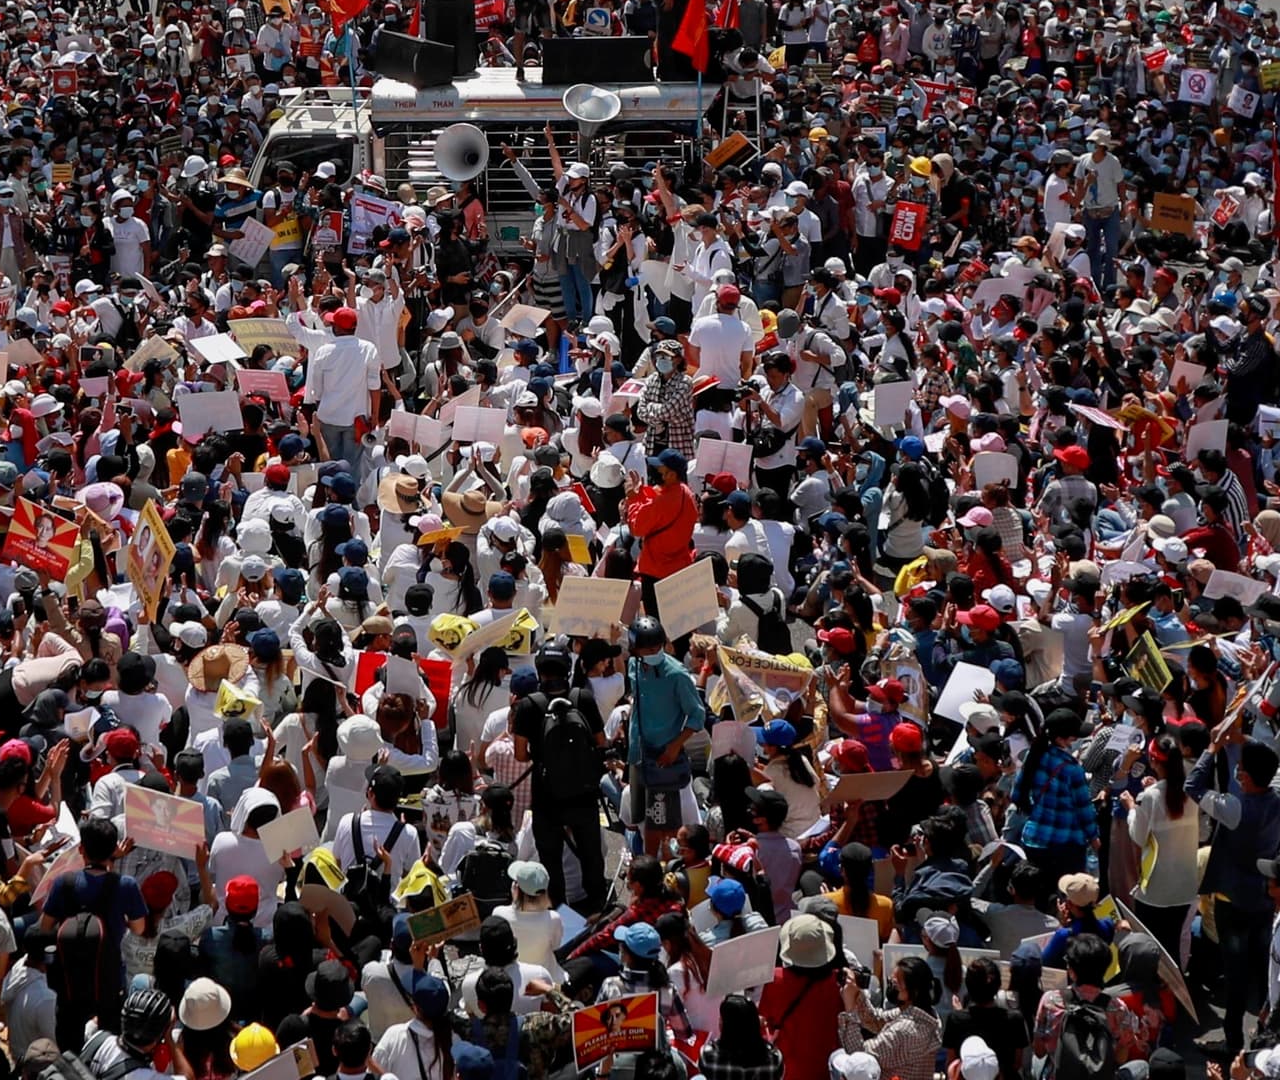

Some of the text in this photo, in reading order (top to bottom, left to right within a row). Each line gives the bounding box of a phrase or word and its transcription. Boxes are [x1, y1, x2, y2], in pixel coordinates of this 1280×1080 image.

[901, 211, 918, 241] CDM
[728, 654, 799, 673] JUSTICE FOR
[585, 1033, 608, 1048] PLEASE
